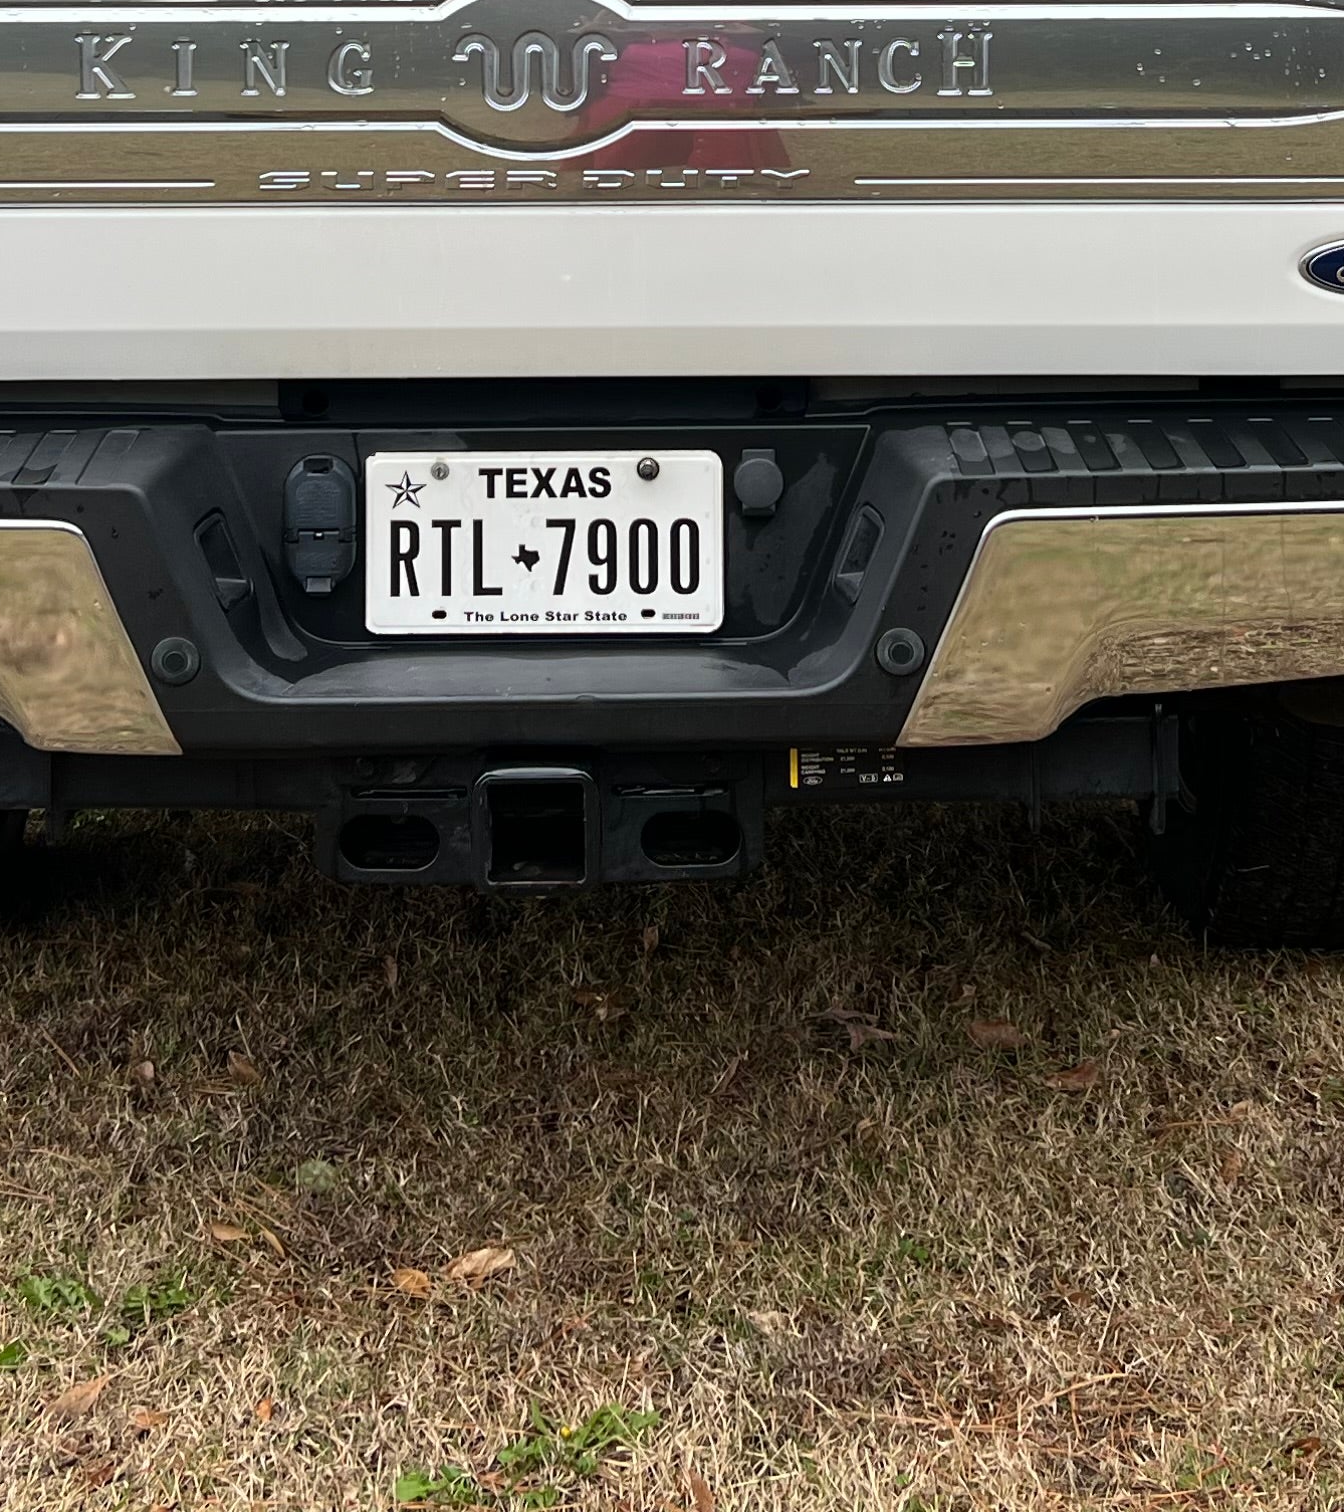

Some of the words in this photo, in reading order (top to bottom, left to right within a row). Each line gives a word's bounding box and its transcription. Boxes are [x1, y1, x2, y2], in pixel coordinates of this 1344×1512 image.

[74, 32, 375, 100] KING
[681, 31, 994, 96] RANCH
[259, 170, 559, 191] SUPER
[582, 169, 810, 189] DUTY
[478, 467, 612, 498] TEXAS
[389, 519, 504, 597] RTL
[545, 518, 700, 596] 7900
[464, 611, 494, 622] The
[500, 611, 539, 622] Lone
[545, 610, 579, 622] Star
[584, 610, 628, 621] State
